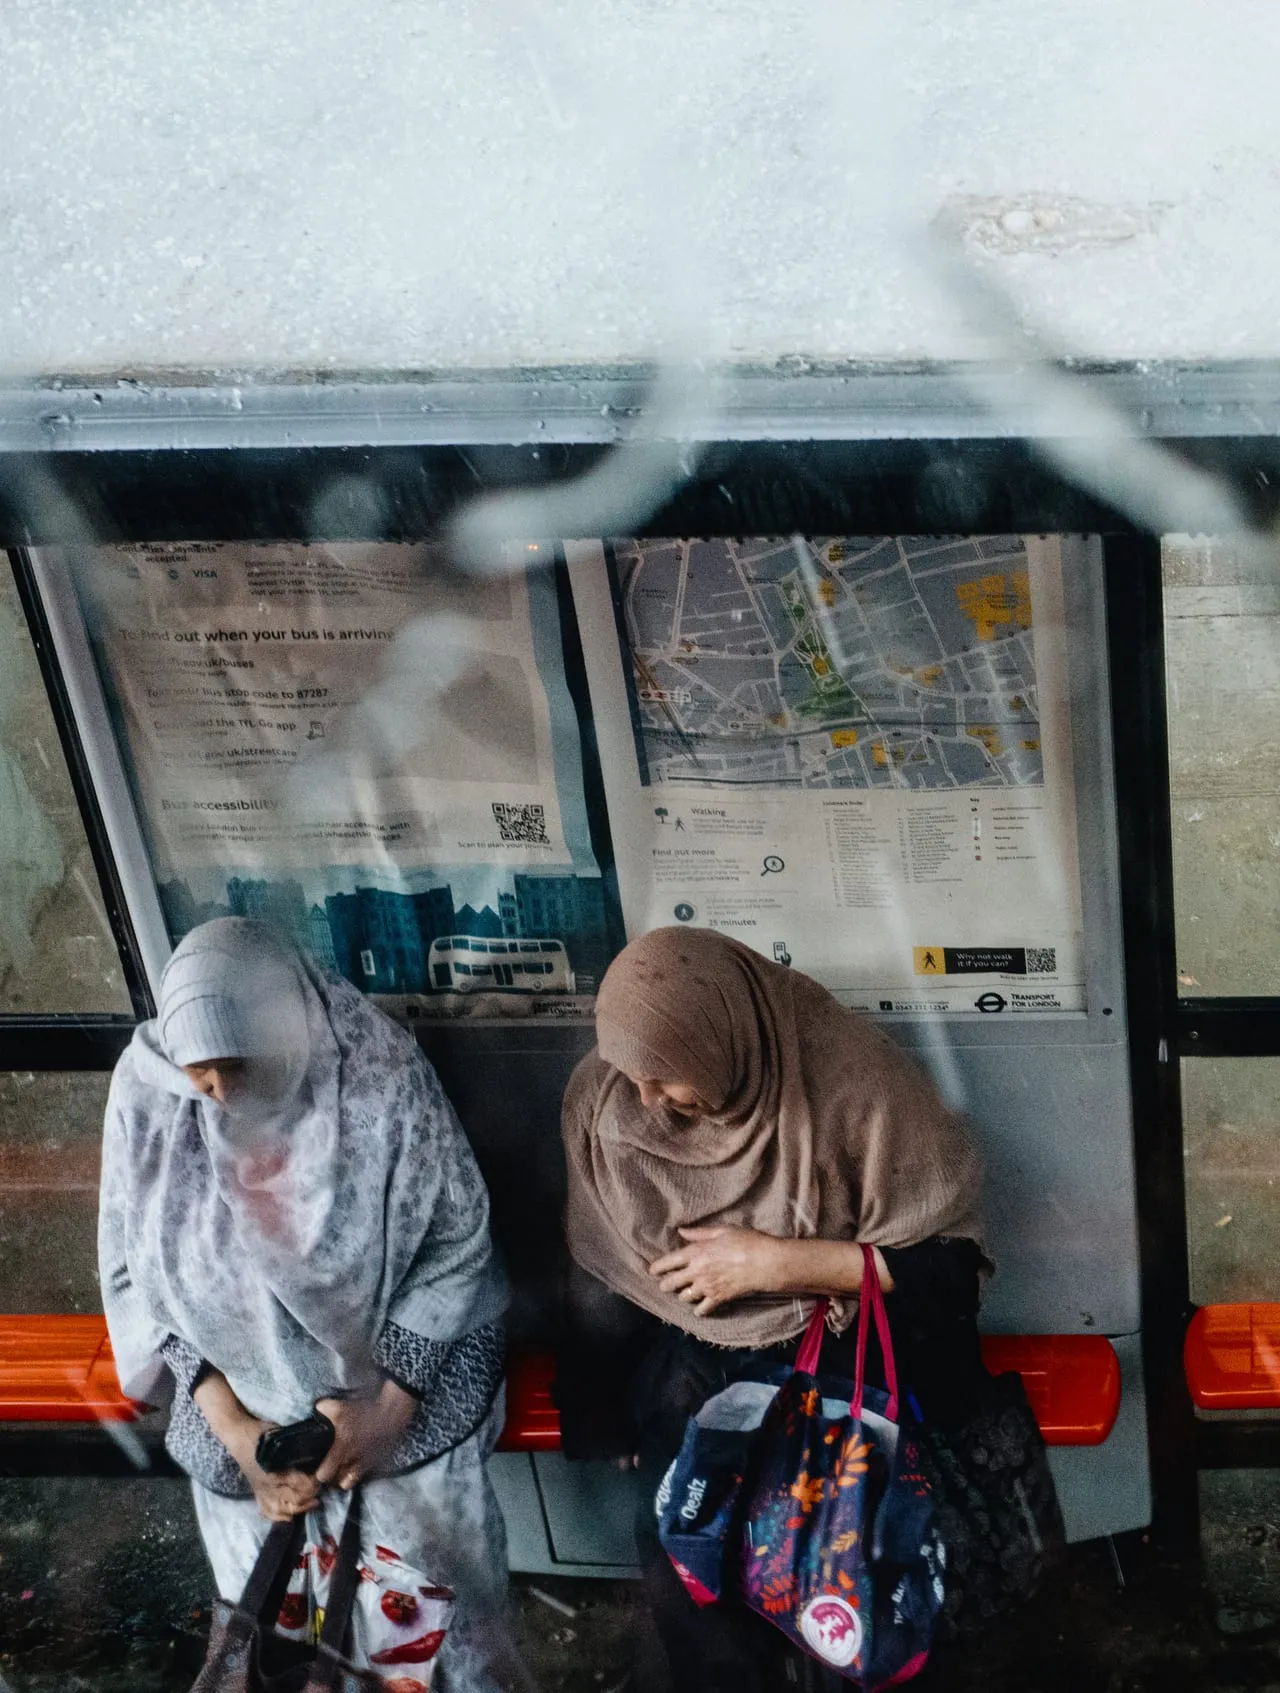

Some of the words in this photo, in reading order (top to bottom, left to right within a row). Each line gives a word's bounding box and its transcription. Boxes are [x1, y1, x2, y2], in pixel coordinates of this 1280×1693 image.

[192, 569, 218, 579] VISA
[174, 631, 200, 642] out
[204, 630, 248, 642] when
[252, 630, 287, 642] your
[291, 629, 319, 640] bus
[323, 629, 335, 640] is
[202, 688, 222, 697] bus
[225, 689, 250, 698] stop
[252, 690, 279, 699] code
[281, 690, 294, 699] to
[216, 718, 235, 728] the
[238, 719, 256, 728] TfL
[258, 720, 273, 728] Go
[276, 722, 296, 731] app
[193, 799, 279, 810] accessibility
[690, 808, 727, 817] Walking
[956, 953, 975, 961] Why
[681, 1477, 707, 1520] Dealz
